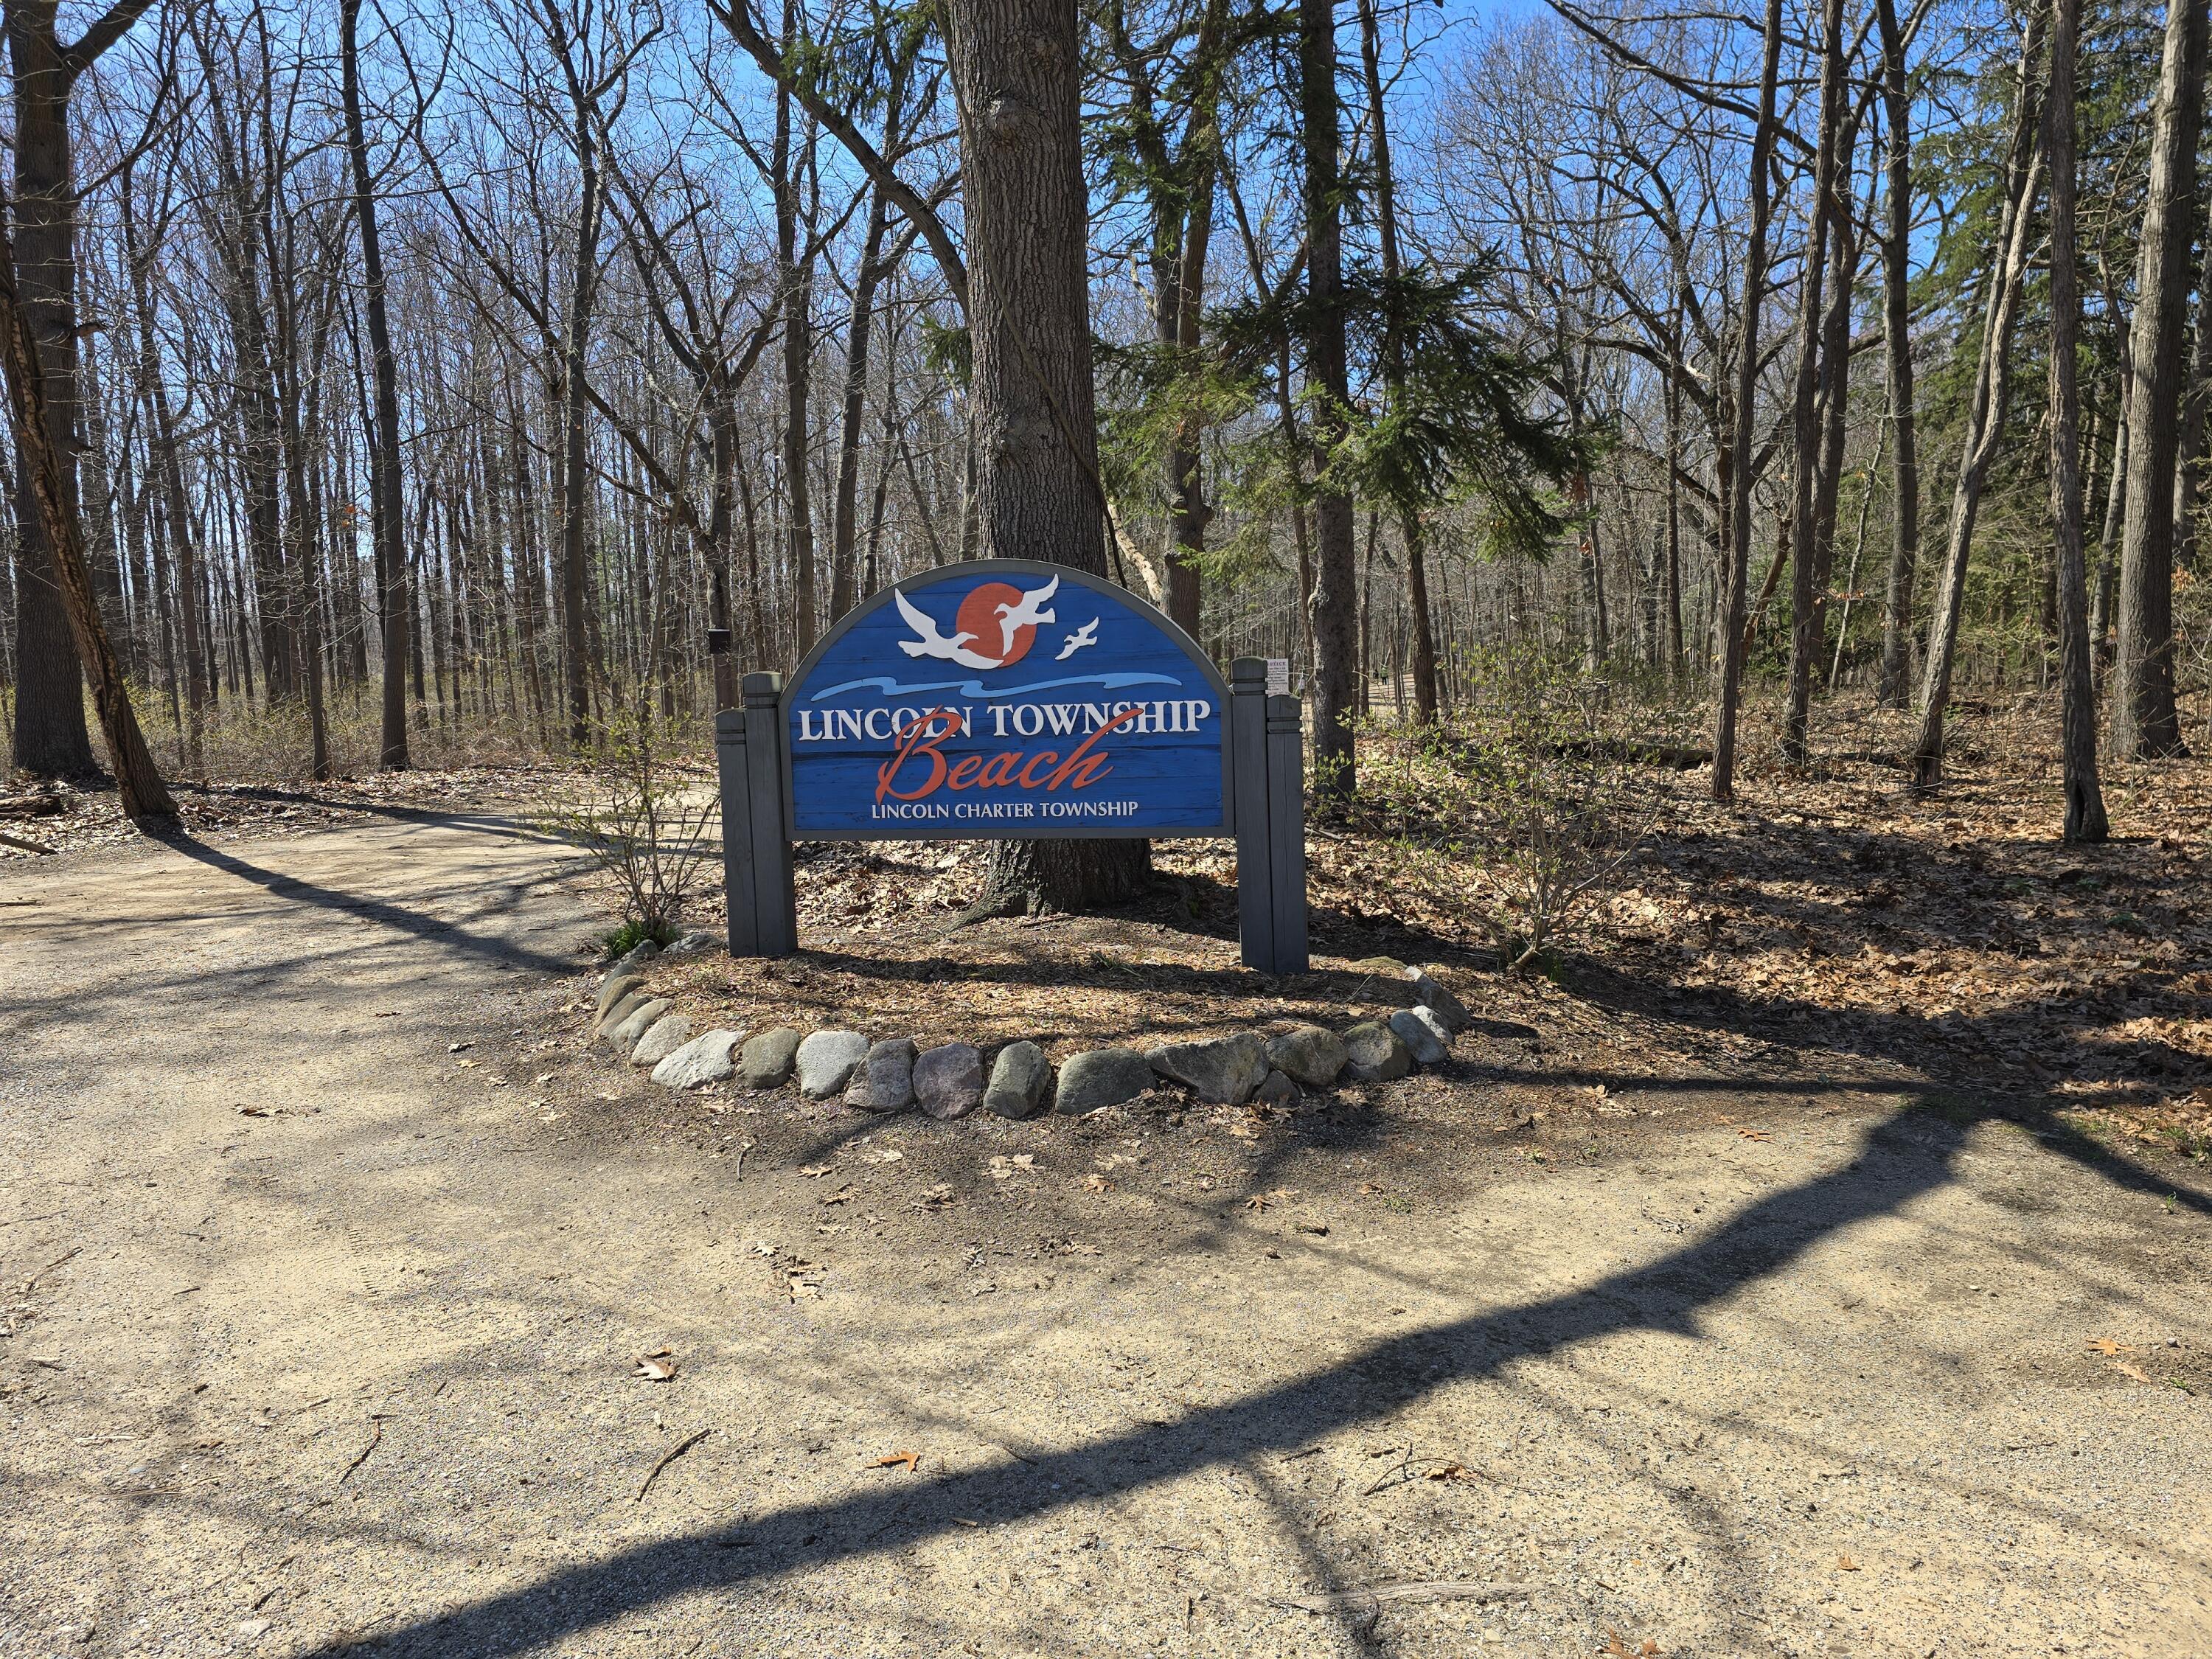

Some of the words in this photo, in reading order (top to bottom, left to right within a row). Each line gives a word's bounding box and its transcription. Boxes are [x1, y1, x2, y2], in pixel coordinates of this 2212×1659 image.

[798, 706, 973, 740] LINCOLN
[987, 700, 1211, 737] TOWNSHIP
[875, 704, 1144, 806] Beach
[872, 804, 949, 819] LINCOLN
[954, 803, 1034, 818] CHARTER
[1039, 801, 1138, 817] TOWNSHIP
